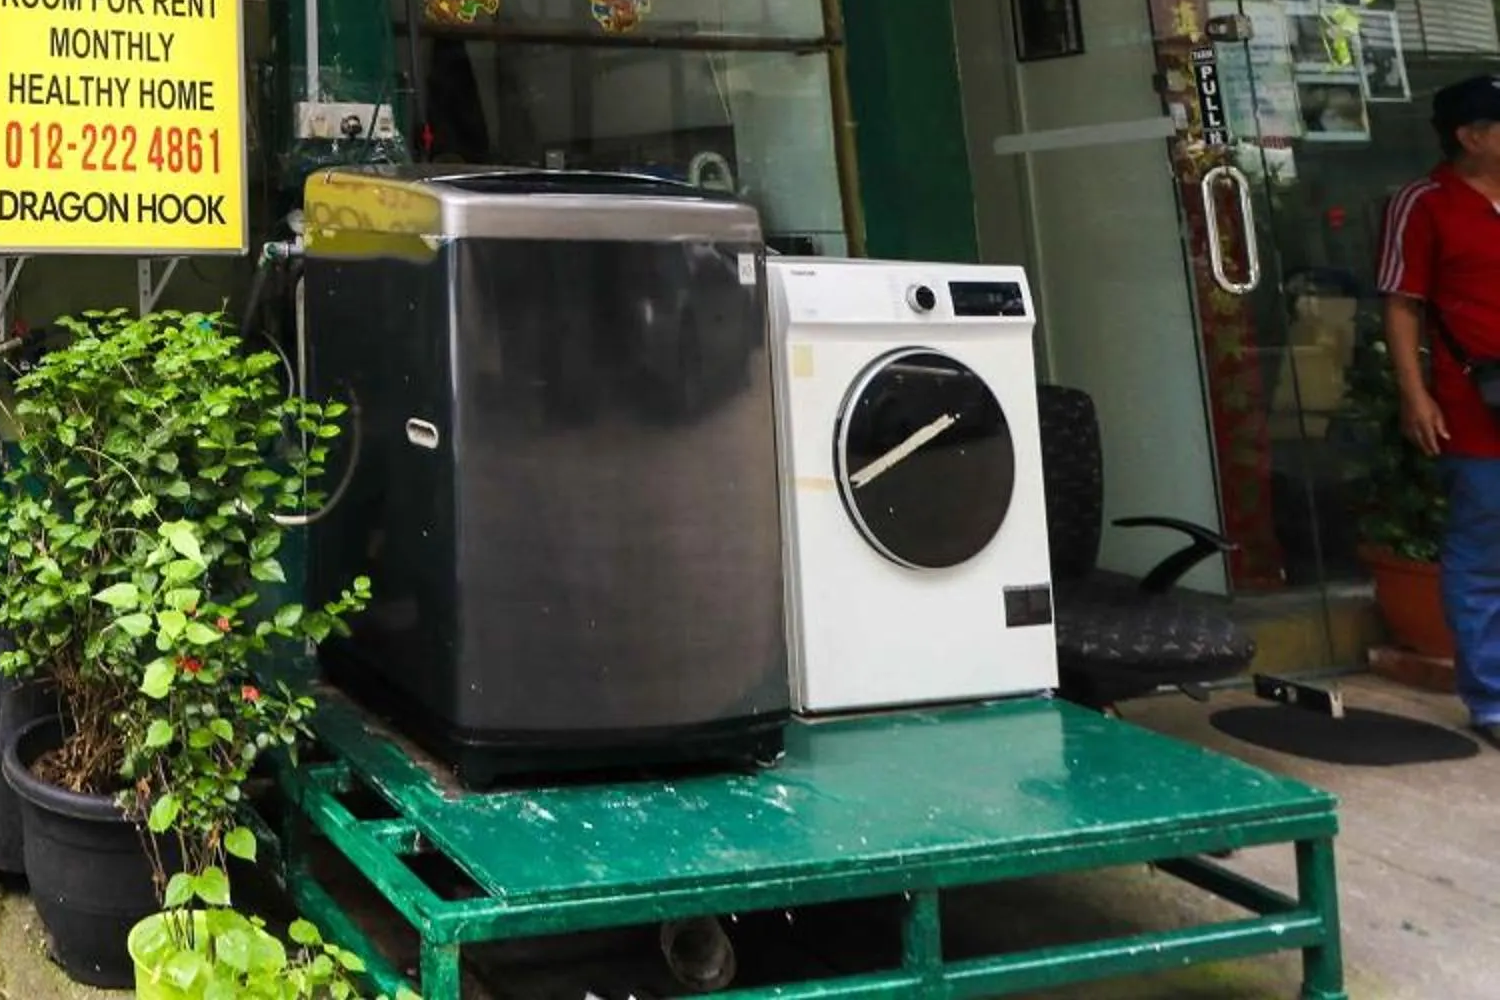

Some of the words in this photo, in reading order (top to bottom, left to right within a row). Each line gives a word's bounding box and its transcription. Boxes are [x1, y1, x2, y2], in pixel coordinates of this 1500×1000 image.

[49, 27, 175, 62] MONTHLY
[8, 72, 130, 107] HEALTHY
[139, 77, 215, 111] HOME
[1201, 65, 1221, 127] PULL
[5, 120, 137, 172] 012-222
[147, 125, 221, 175] 4861
[137, 194, 227, 225] HOOK
